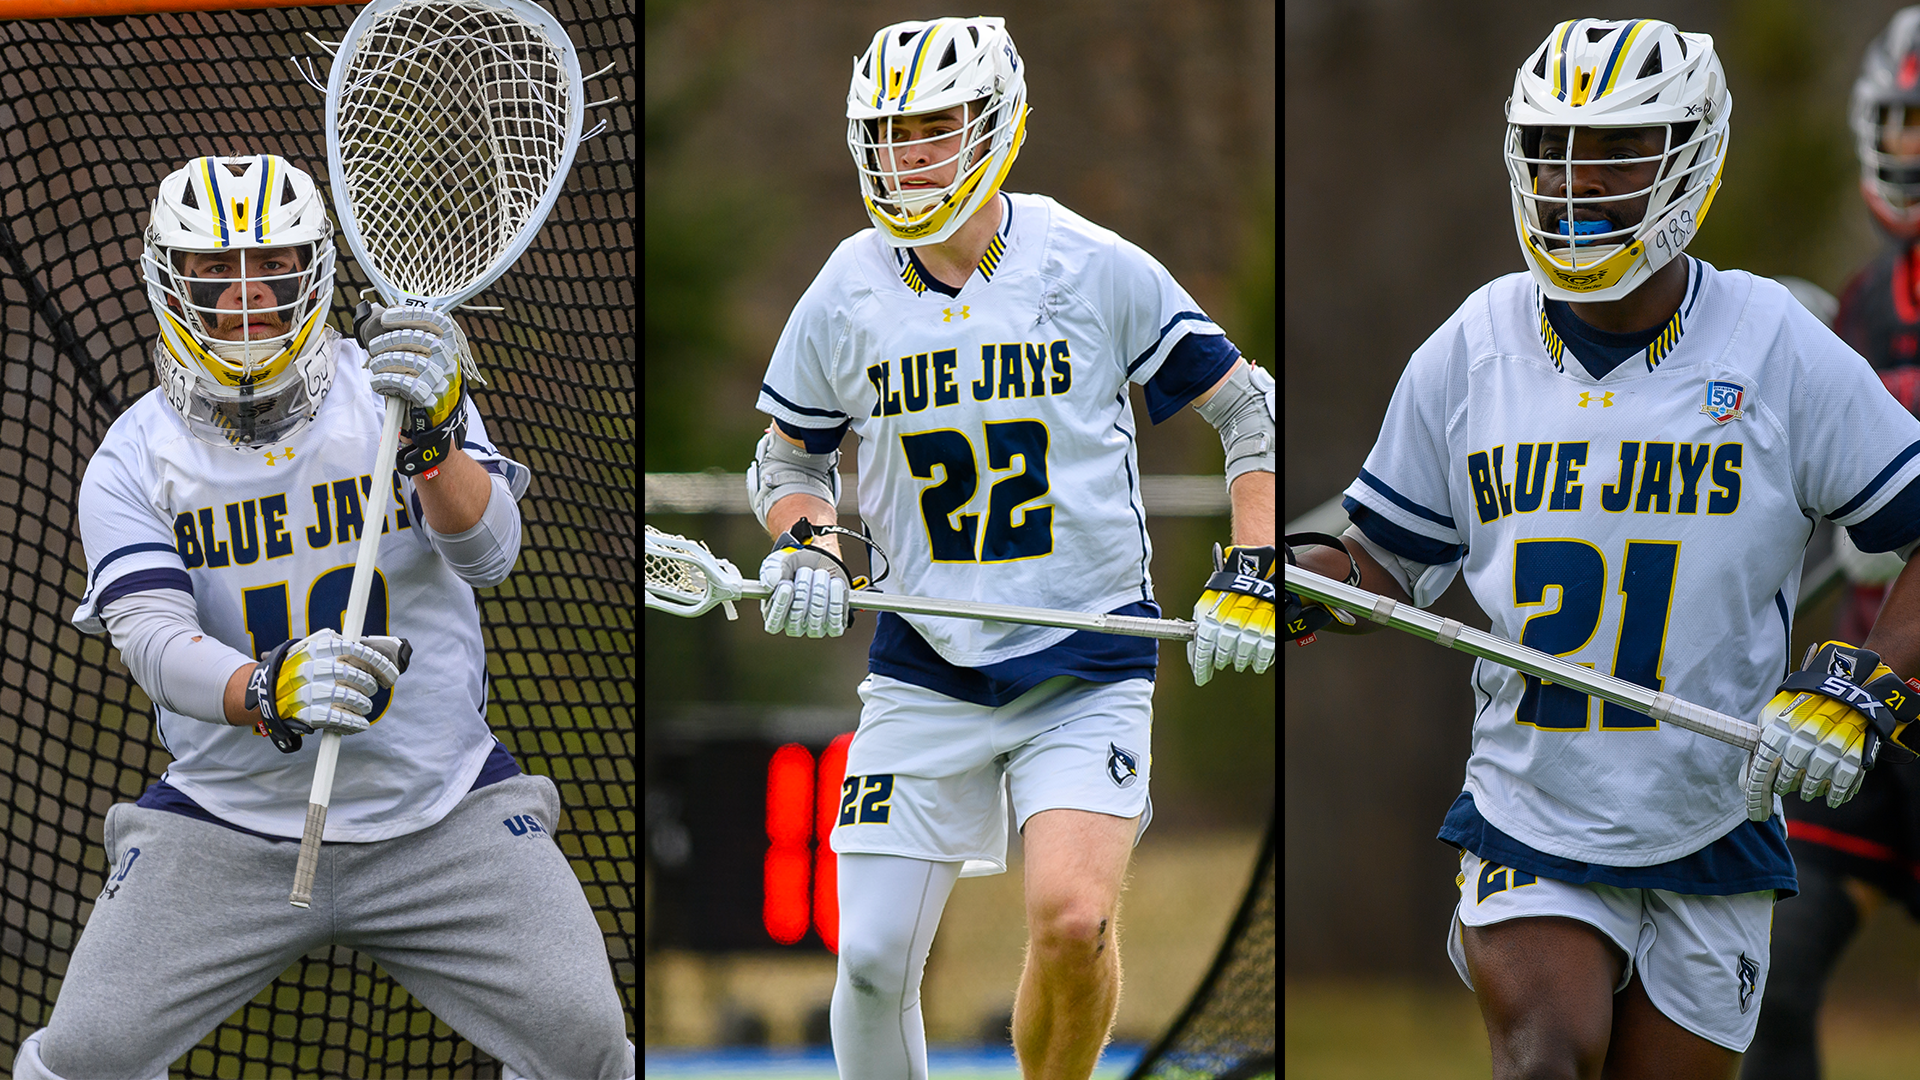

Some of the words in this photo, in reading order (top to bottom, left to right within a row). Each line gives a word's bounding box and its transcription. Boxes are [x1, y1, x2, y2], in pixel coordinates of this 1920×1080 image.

[1656, 209, 1693, 255] 988
[405, 298, 428, 309] STX
[971, 338, 1073, 402] JAYS
[1712, 390, 1737, 408] 50
[416, 418, 426, 431] STX
[422, 446, 440, 462] 10
[792, 449, 812, 459] RIGHT
[898, 417, 1056, 565] 22
[1467, 440, 1590, 526] BLUE
[1600, 440, 1744, 516] JAYS
[173, 492, 294, 571] BLUE
[1287, 618, 1307, 634] 21
[1511, 537, 1682, 733] 21
[1819, 676, 1885, 720] STX
[1884, 689, 1907, 712] 21
[838, 773, 897, 829] 22
[1476, 857, 1538, 907] 2
